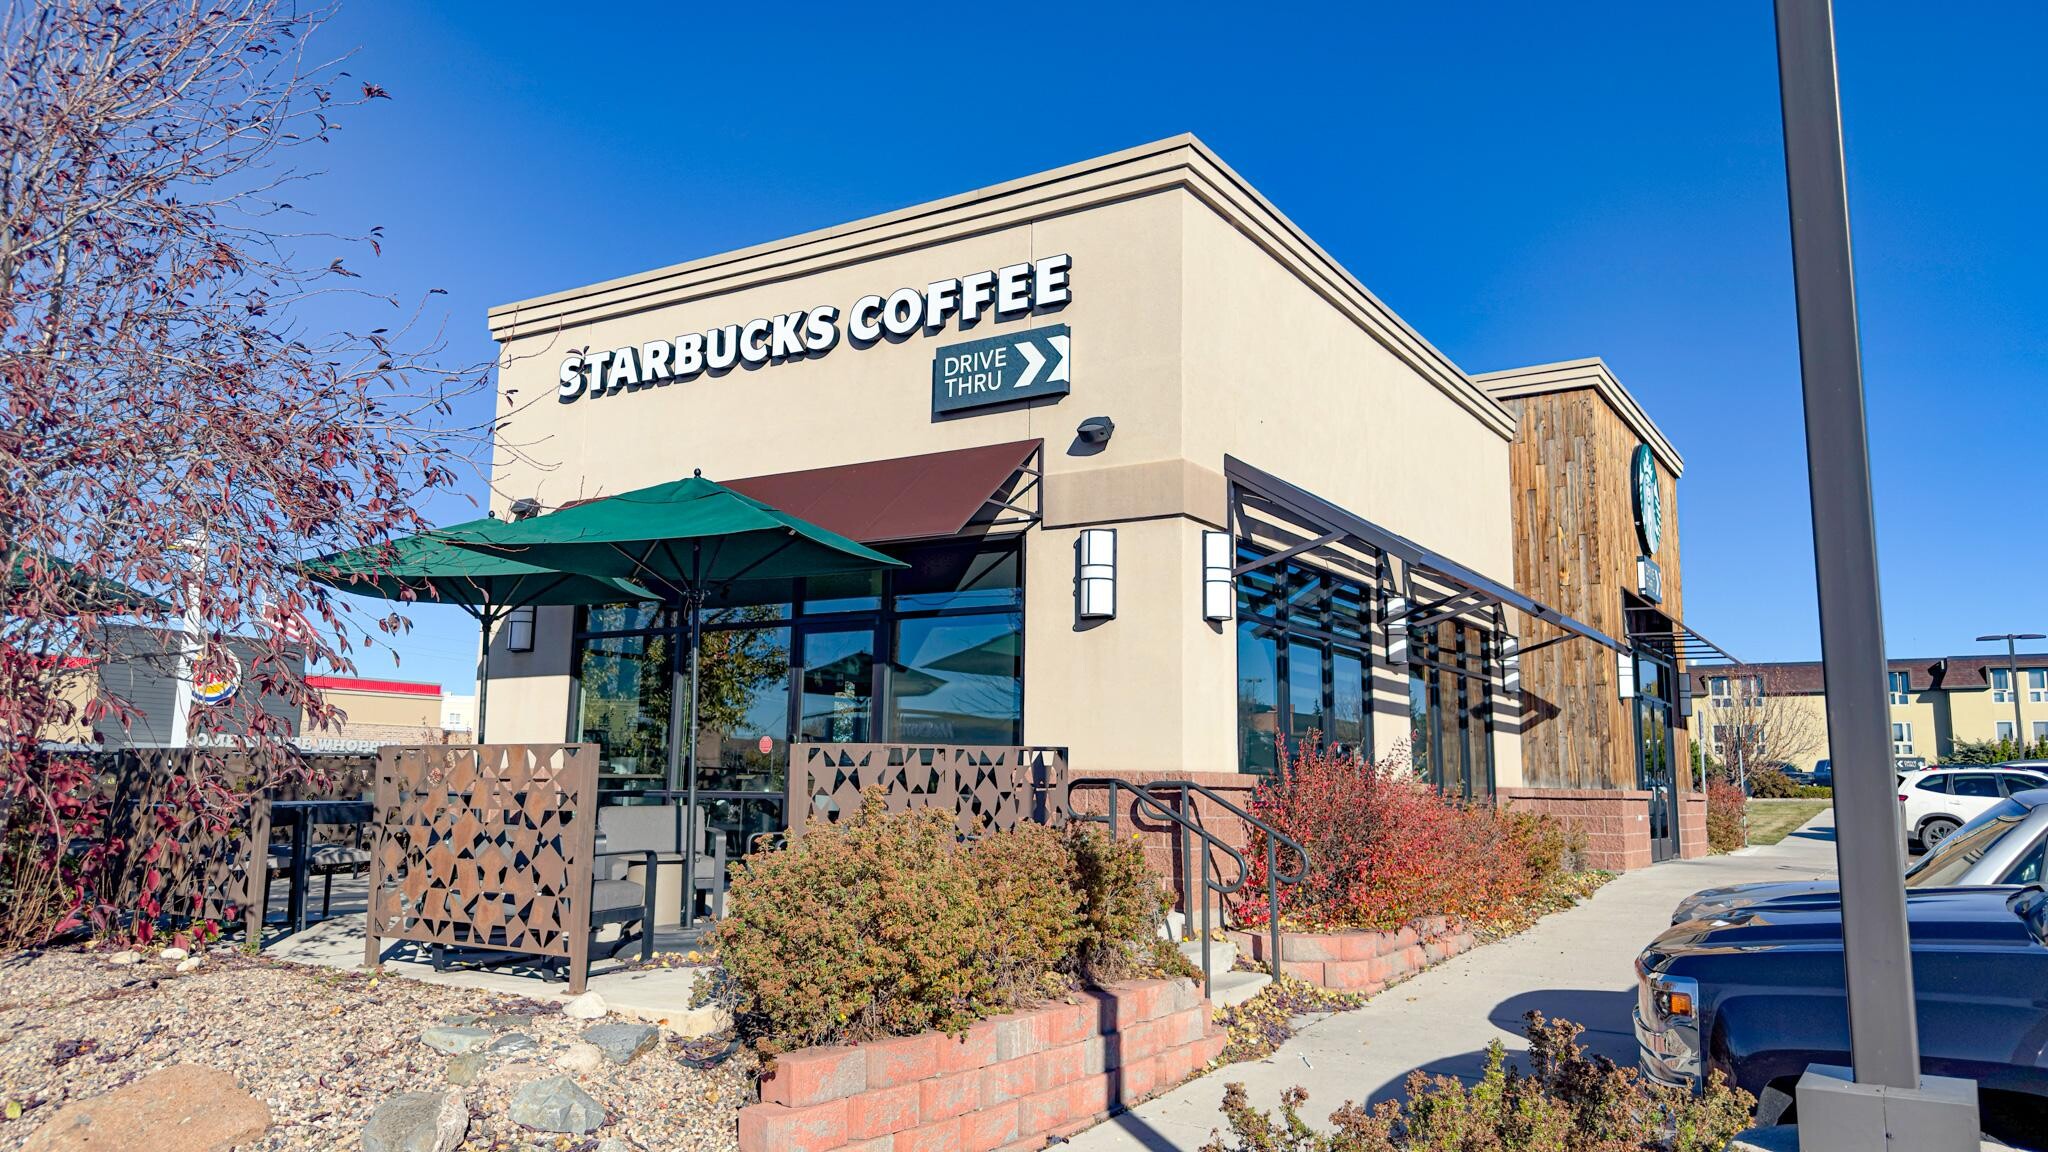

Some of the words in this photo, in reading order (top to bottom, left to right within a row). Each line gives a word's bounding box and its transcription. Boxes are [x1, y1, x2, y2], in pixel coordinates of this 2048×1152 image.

[559, 306, 840, 402] STARBUCKS
[848, 253, 1072, 348] COFFEE
[944, 347, 1007, 377] DRIVE
[944, 370, 1002, 398] THRU
